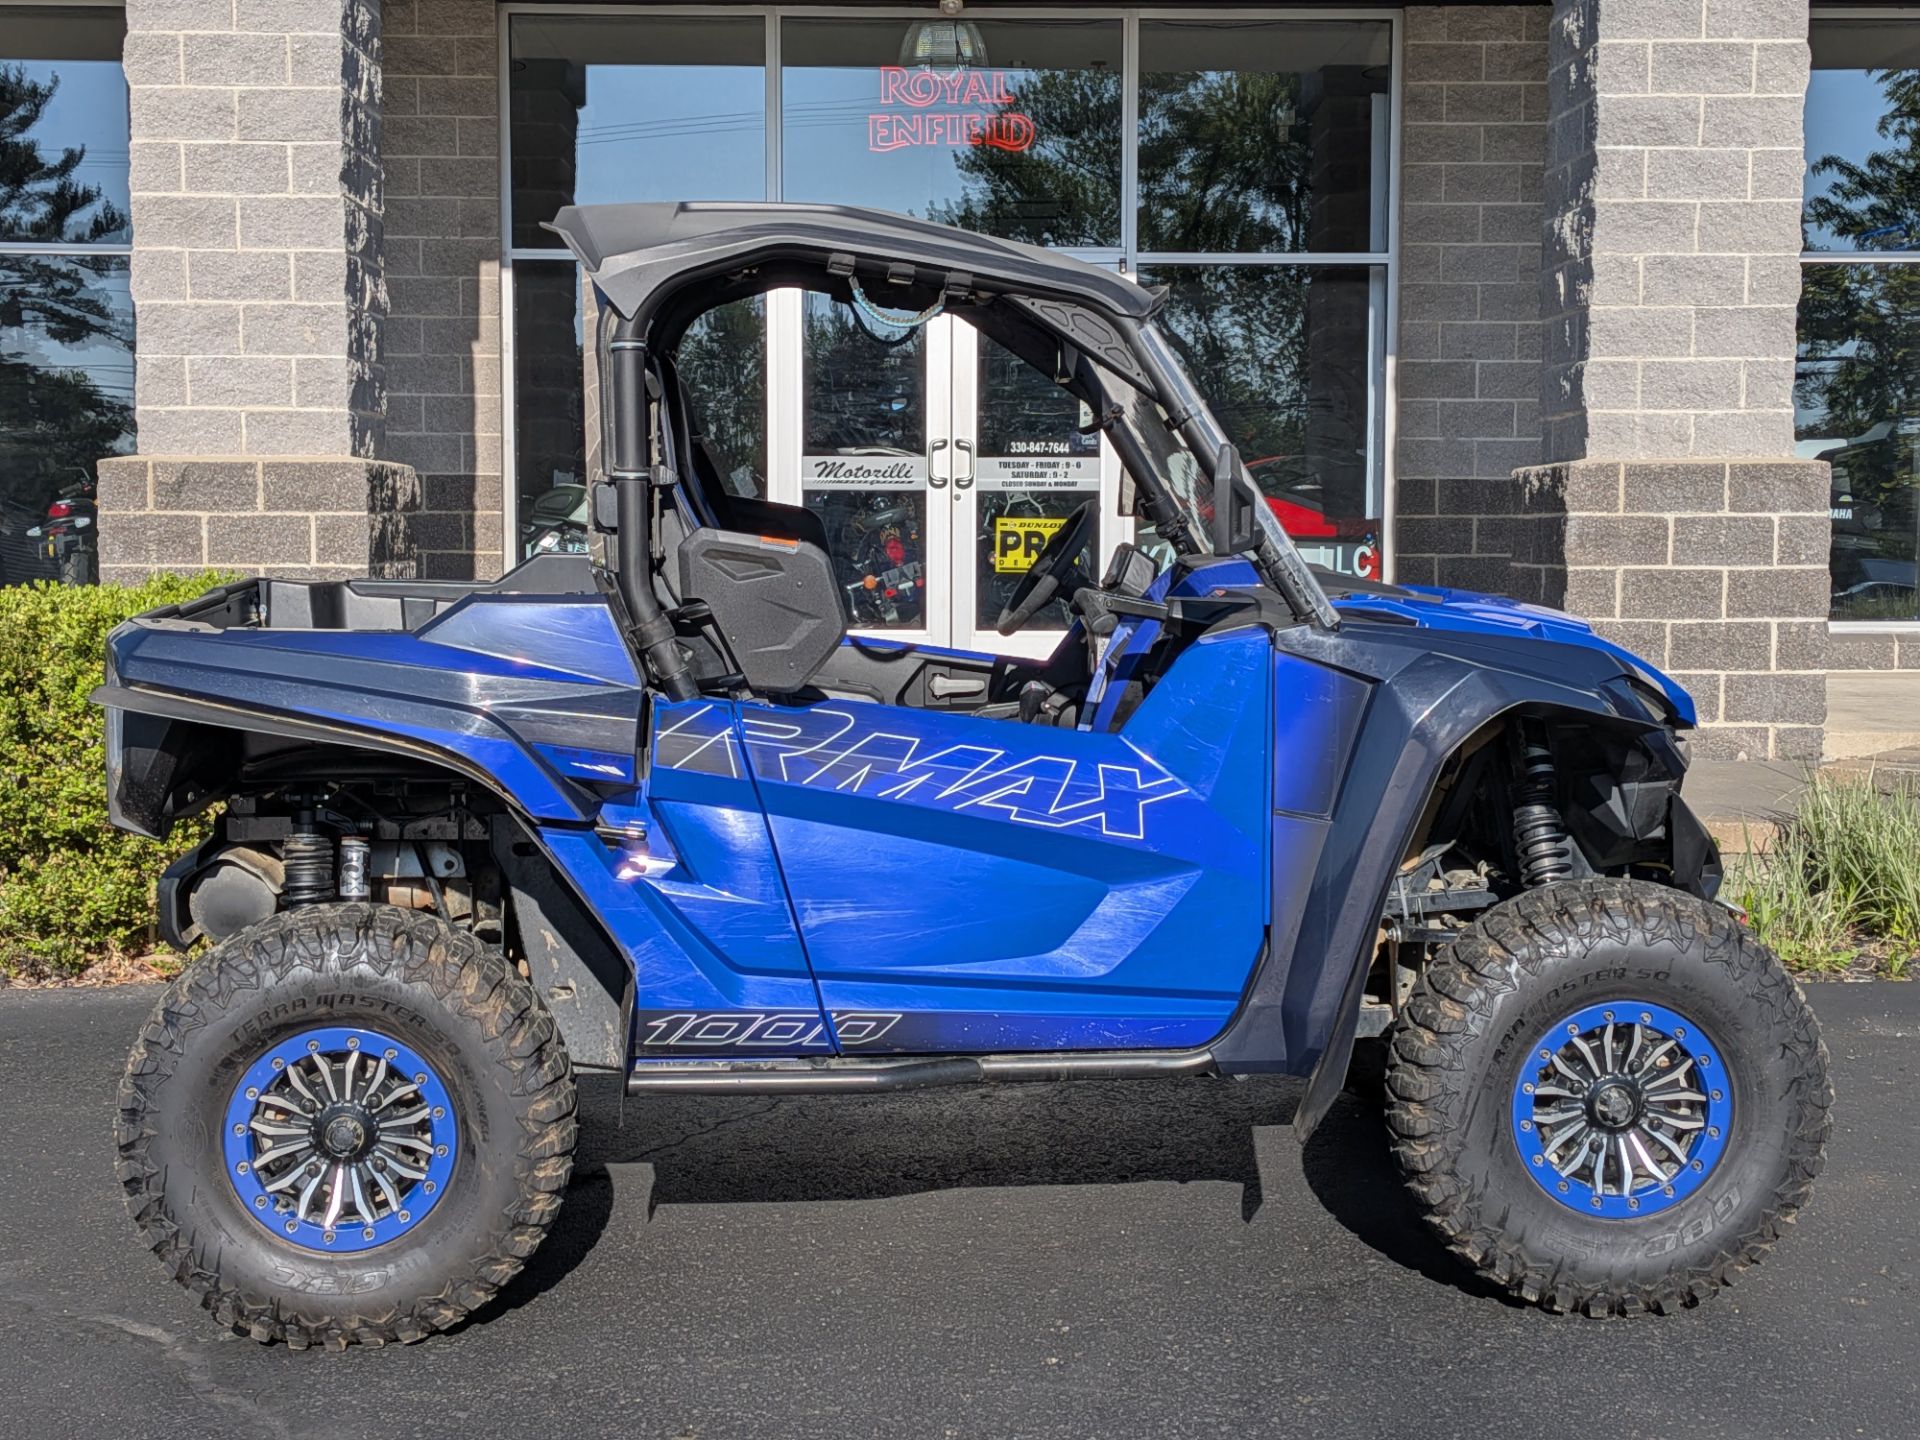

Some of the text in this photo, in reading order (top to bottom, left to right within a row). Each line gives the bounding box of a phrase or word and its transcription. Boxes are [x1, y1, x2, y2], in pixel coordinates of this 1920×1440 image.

[880, 66, 1014, 107] ROYAL
[868, 113, 1035, 152] ENFIELD
[1010, 441, 1070, 453] 330-847-7644
[814, 461, 914, 479] Motozilli
[998, 461, 1030, 469] TUESDAY
[1036, 461, 1060, 469] FRIDAY
[1011, 471, 1048, 479] SATURDAY
[999, 530, 1059, 558] PR
[656, 704, 1190, 839] RMAX
[230, 998, 307, 1043] TERRA
[317, 993, 429, 1028] MASTER
[644, 1013, 902, 1046] 1000
